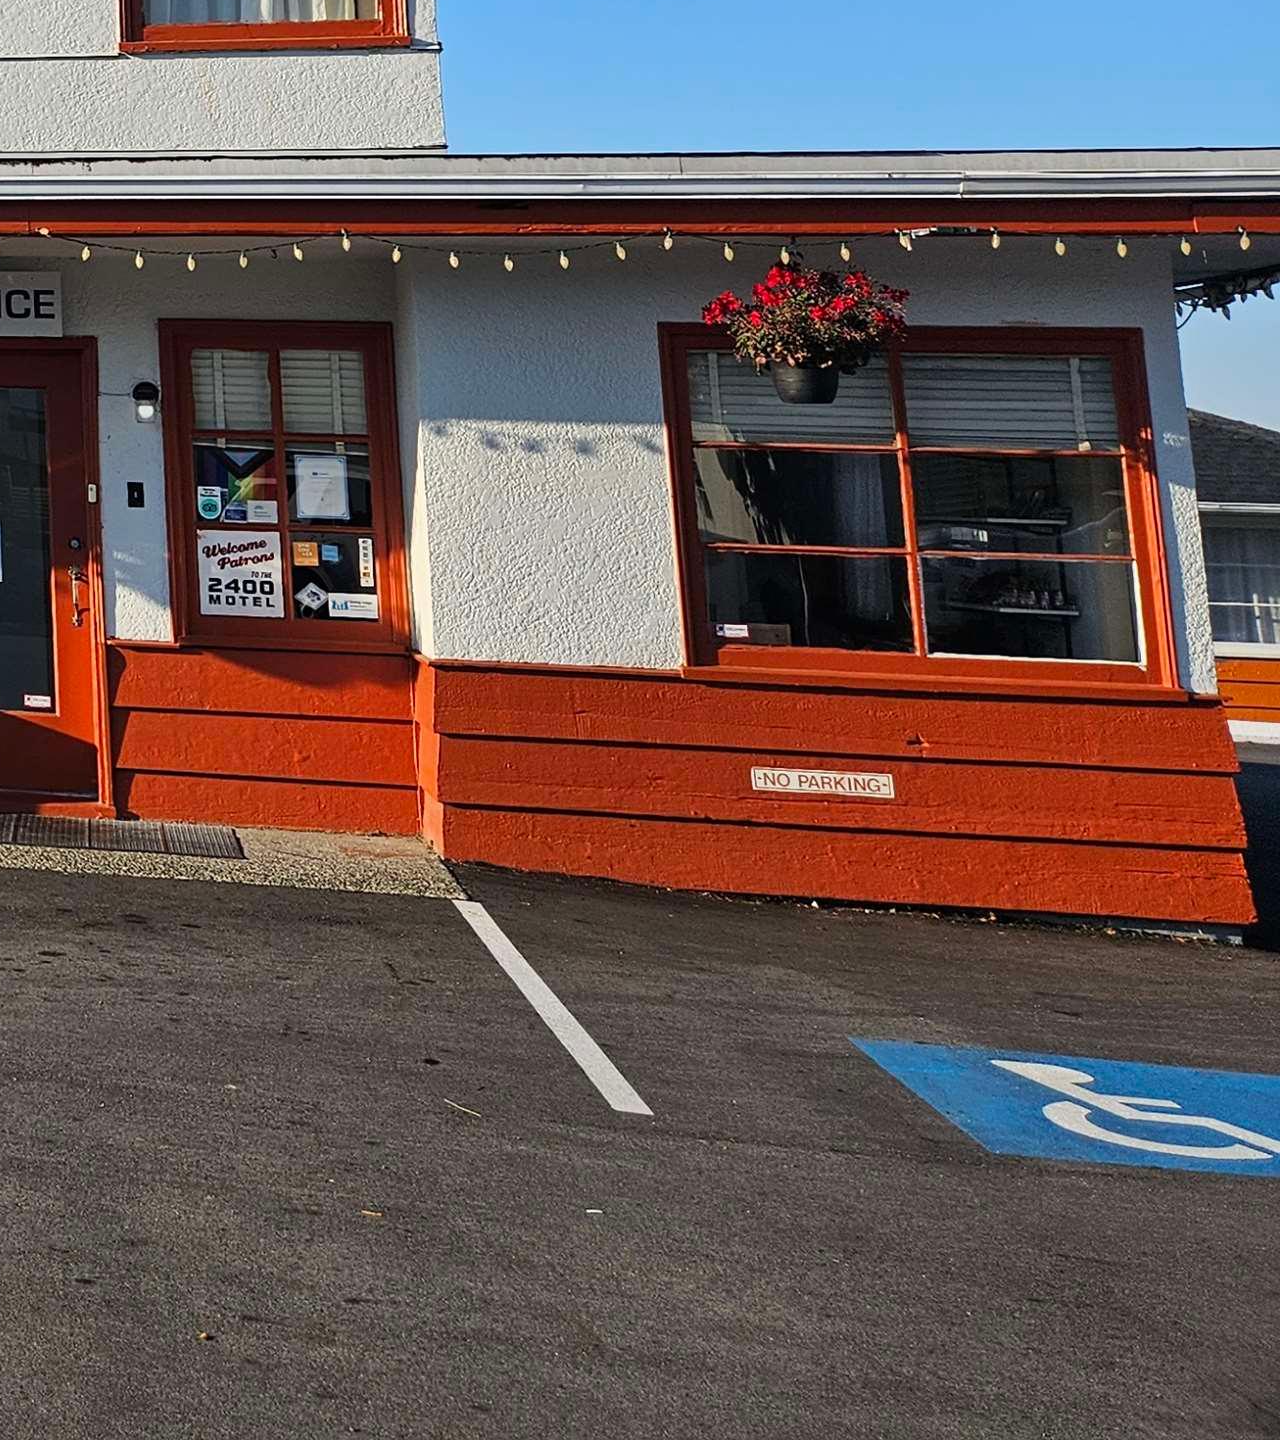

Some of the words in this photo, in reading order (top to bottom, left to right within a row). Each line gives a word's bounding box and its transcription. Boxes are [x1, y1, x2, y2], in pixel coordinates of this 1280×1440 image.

[202, 540, 267, 558] Welcome
[217, 552, 275, 570] Patrons
[208, 577, 275, 596] 2400
[208, 594, 276, 608] MOTEL
[762, 772, 790, 787] NO
[798, 773, 881, 792] PARKING
